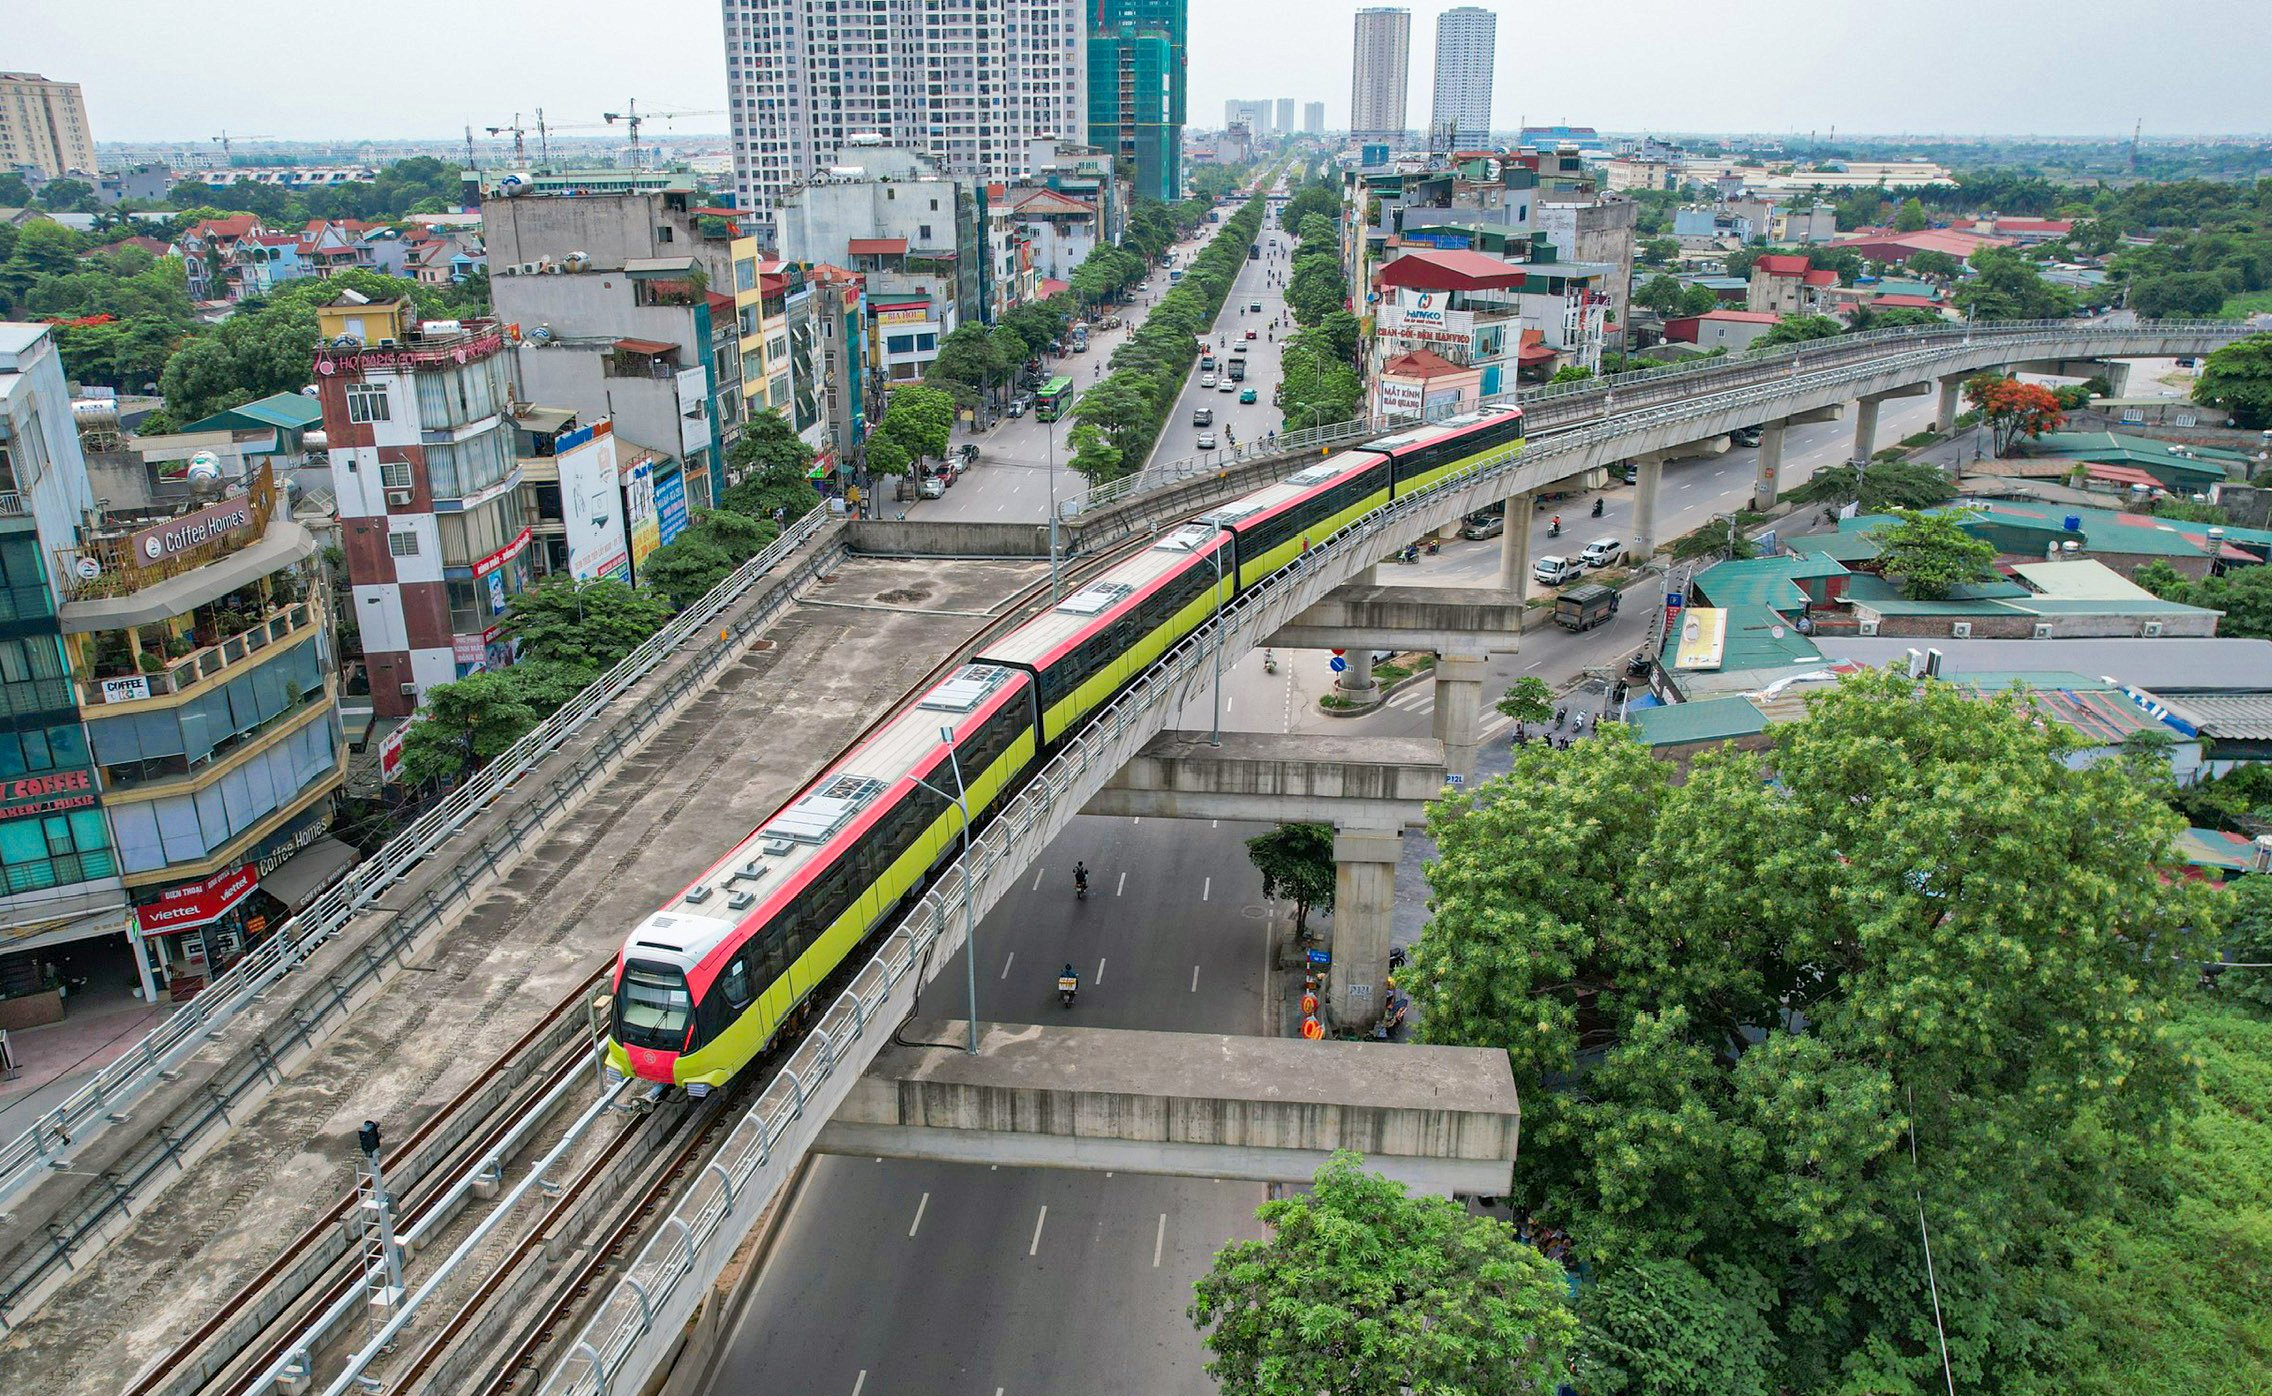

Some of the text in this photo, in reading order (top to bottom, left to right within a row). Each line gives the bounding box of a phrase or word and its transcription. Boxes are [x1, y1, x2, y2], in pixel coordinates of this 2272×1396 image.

[888, 312, 900, 320] BIA
[165, 510, 245, 552] Coffee Homes
[107, 679, 143, 691] COFFEE
[15, 770, 91, 798] COFFEE
[259, 818, 328, 877] Coffee Homes
[220, 876, 248, 901] viettel
[299, 879, 328, 906] COFFEE
[149, 905, 201, 922] viettel
